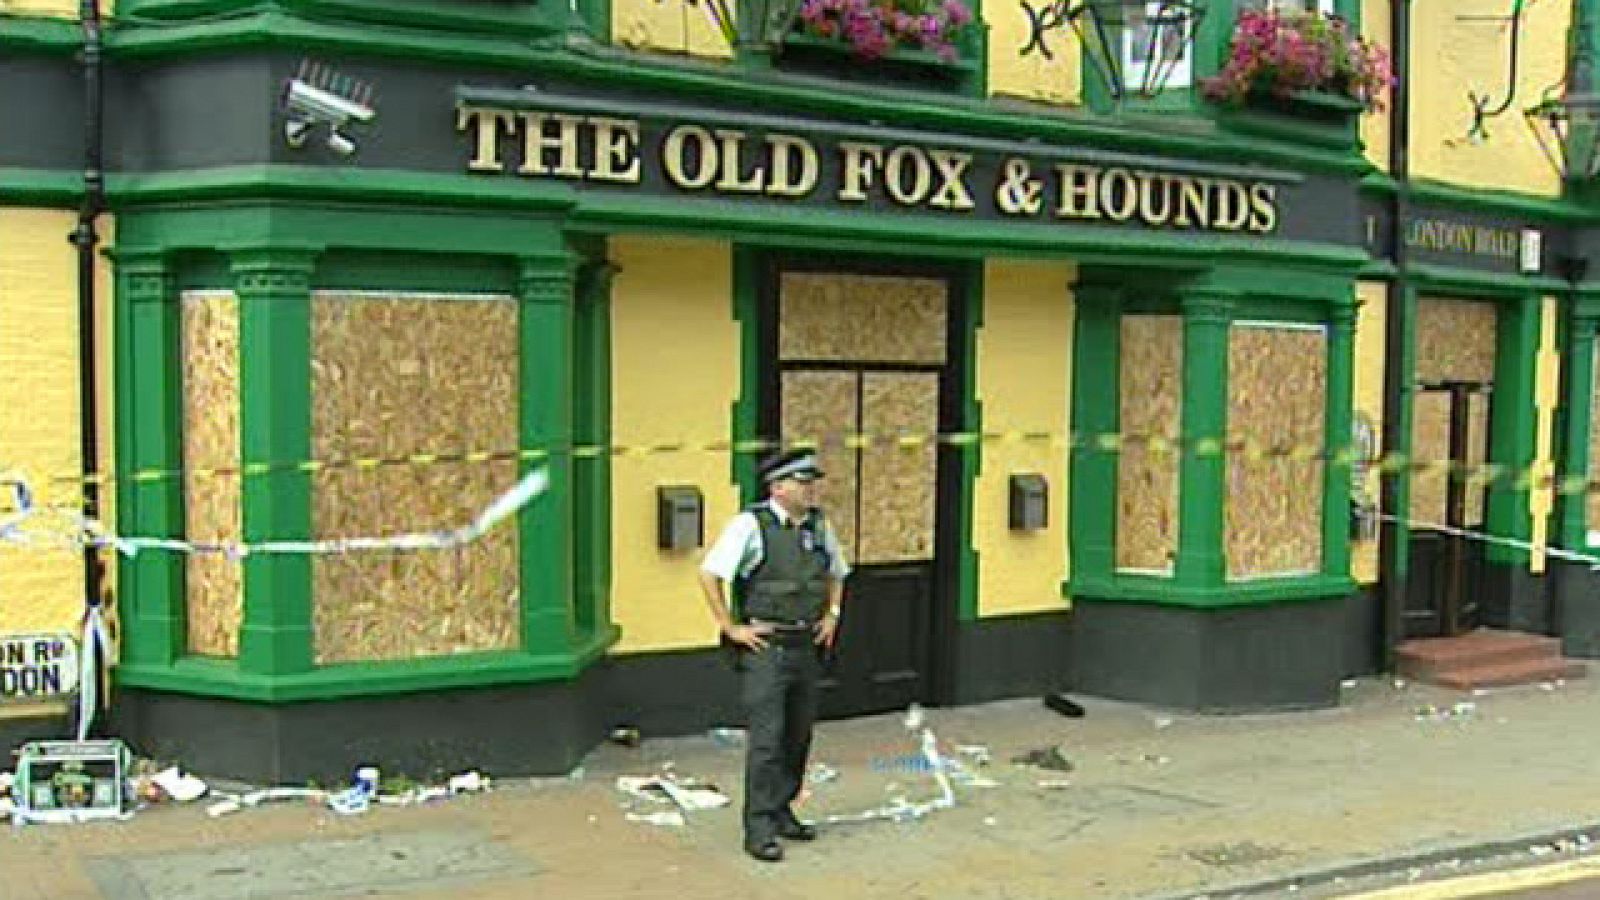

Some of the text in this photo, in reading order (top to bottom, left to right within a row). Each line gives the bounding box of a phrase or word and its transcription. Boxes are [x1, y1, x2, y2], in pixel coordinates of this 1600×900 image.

[456, 106, 1278, 233] THE OLD FOX & HOUNDS
[0, 641, 25, 664] N
